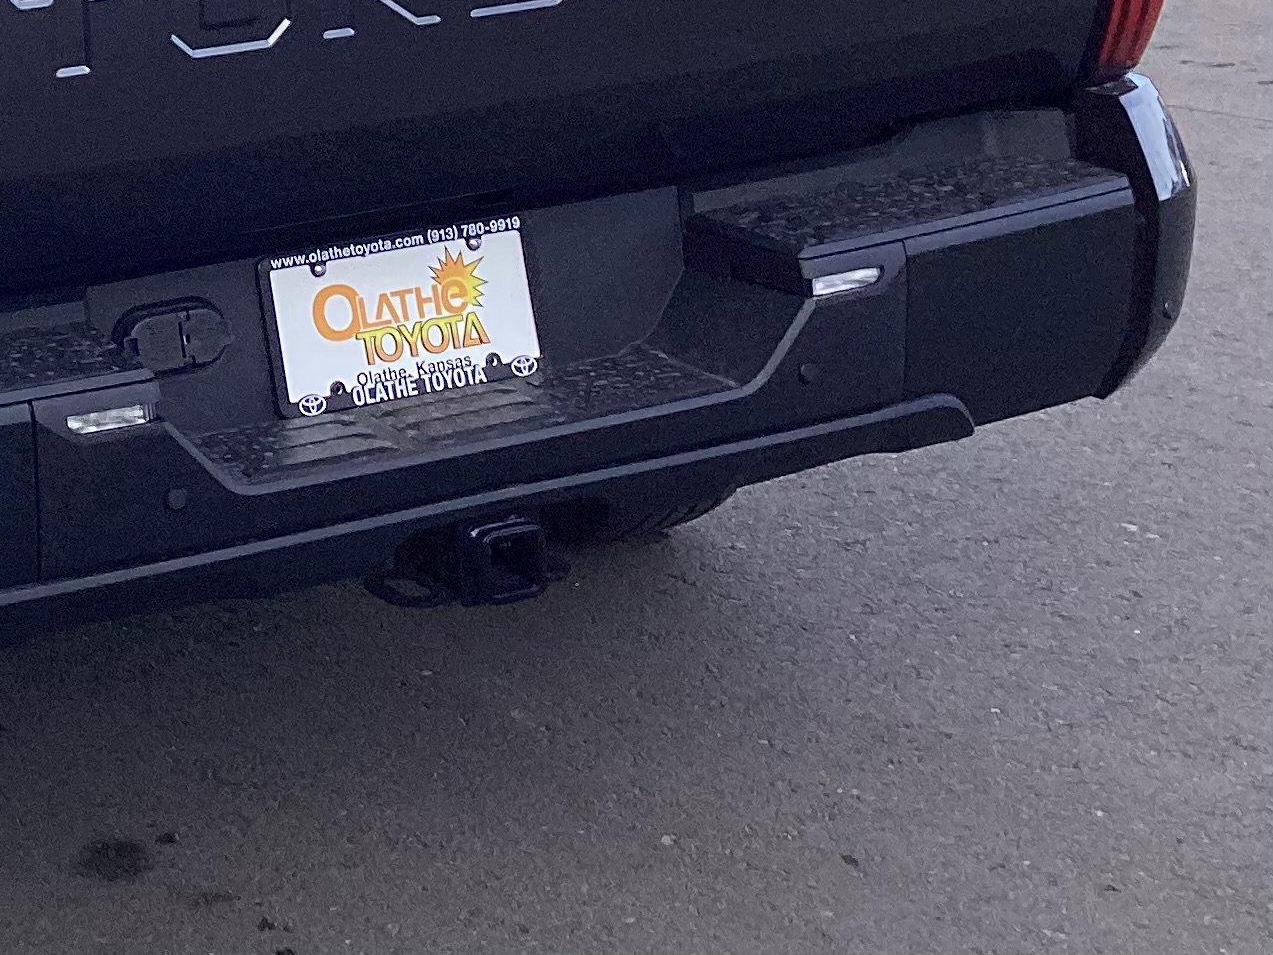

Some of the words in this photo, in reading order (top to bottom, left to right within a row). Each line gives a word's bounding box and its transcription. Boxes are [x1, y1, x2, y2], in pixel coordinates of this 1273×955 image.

[270, 233, 424, 269] www.olathetoyota.com
[427, 224, 459, 245] (913)
[461, 215, 521, 238] 780-9919
[355, 311, 491, 365] TOYOTA
[352, 376, 419, 407] OLATHE
[422, 364, 488, 394] TOYOTA
[416, 354, 472, 376] Kansas
